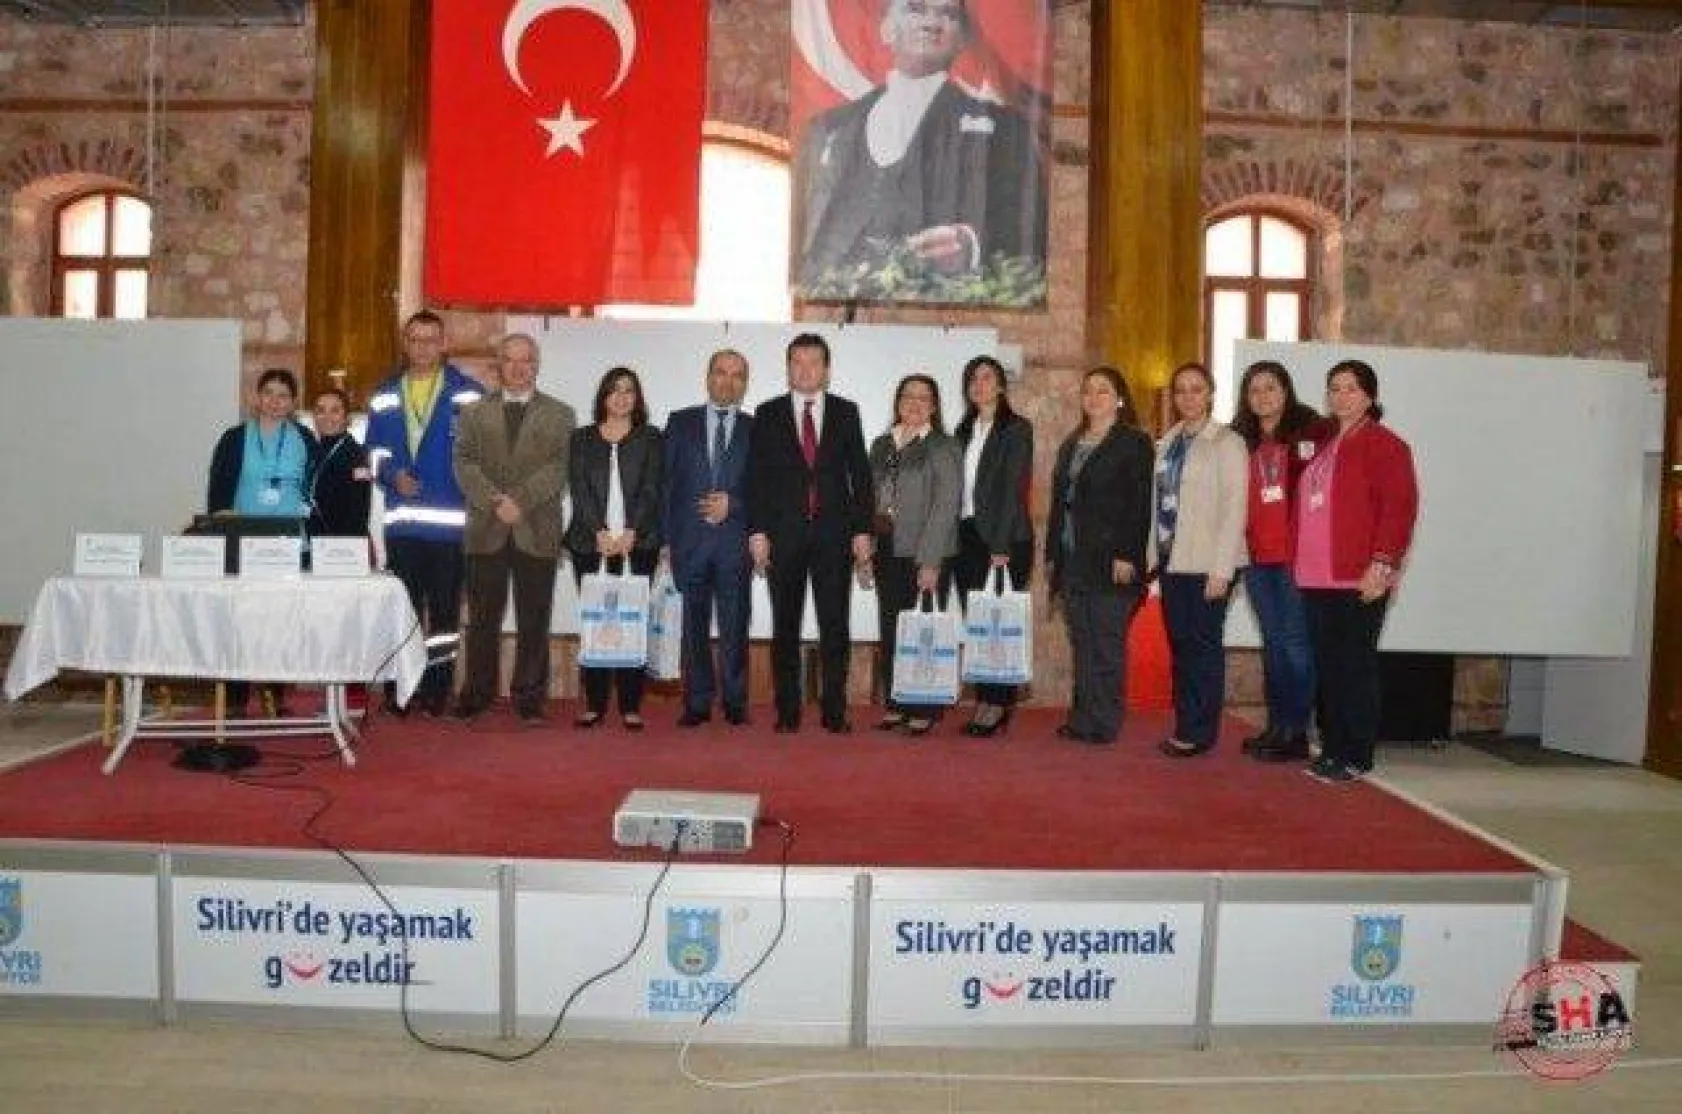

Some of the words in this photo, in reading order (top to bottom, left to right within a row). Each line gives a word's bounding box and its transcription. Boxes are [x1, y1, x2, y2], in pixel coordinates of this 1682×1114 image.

[197, 899, 329, 935] Silivri'de
[339, 909, 474, 945] yaşamak
[896, 922, 1033, 954] Silivri'de
[1041, 922, 1177, 961] yaşamak
